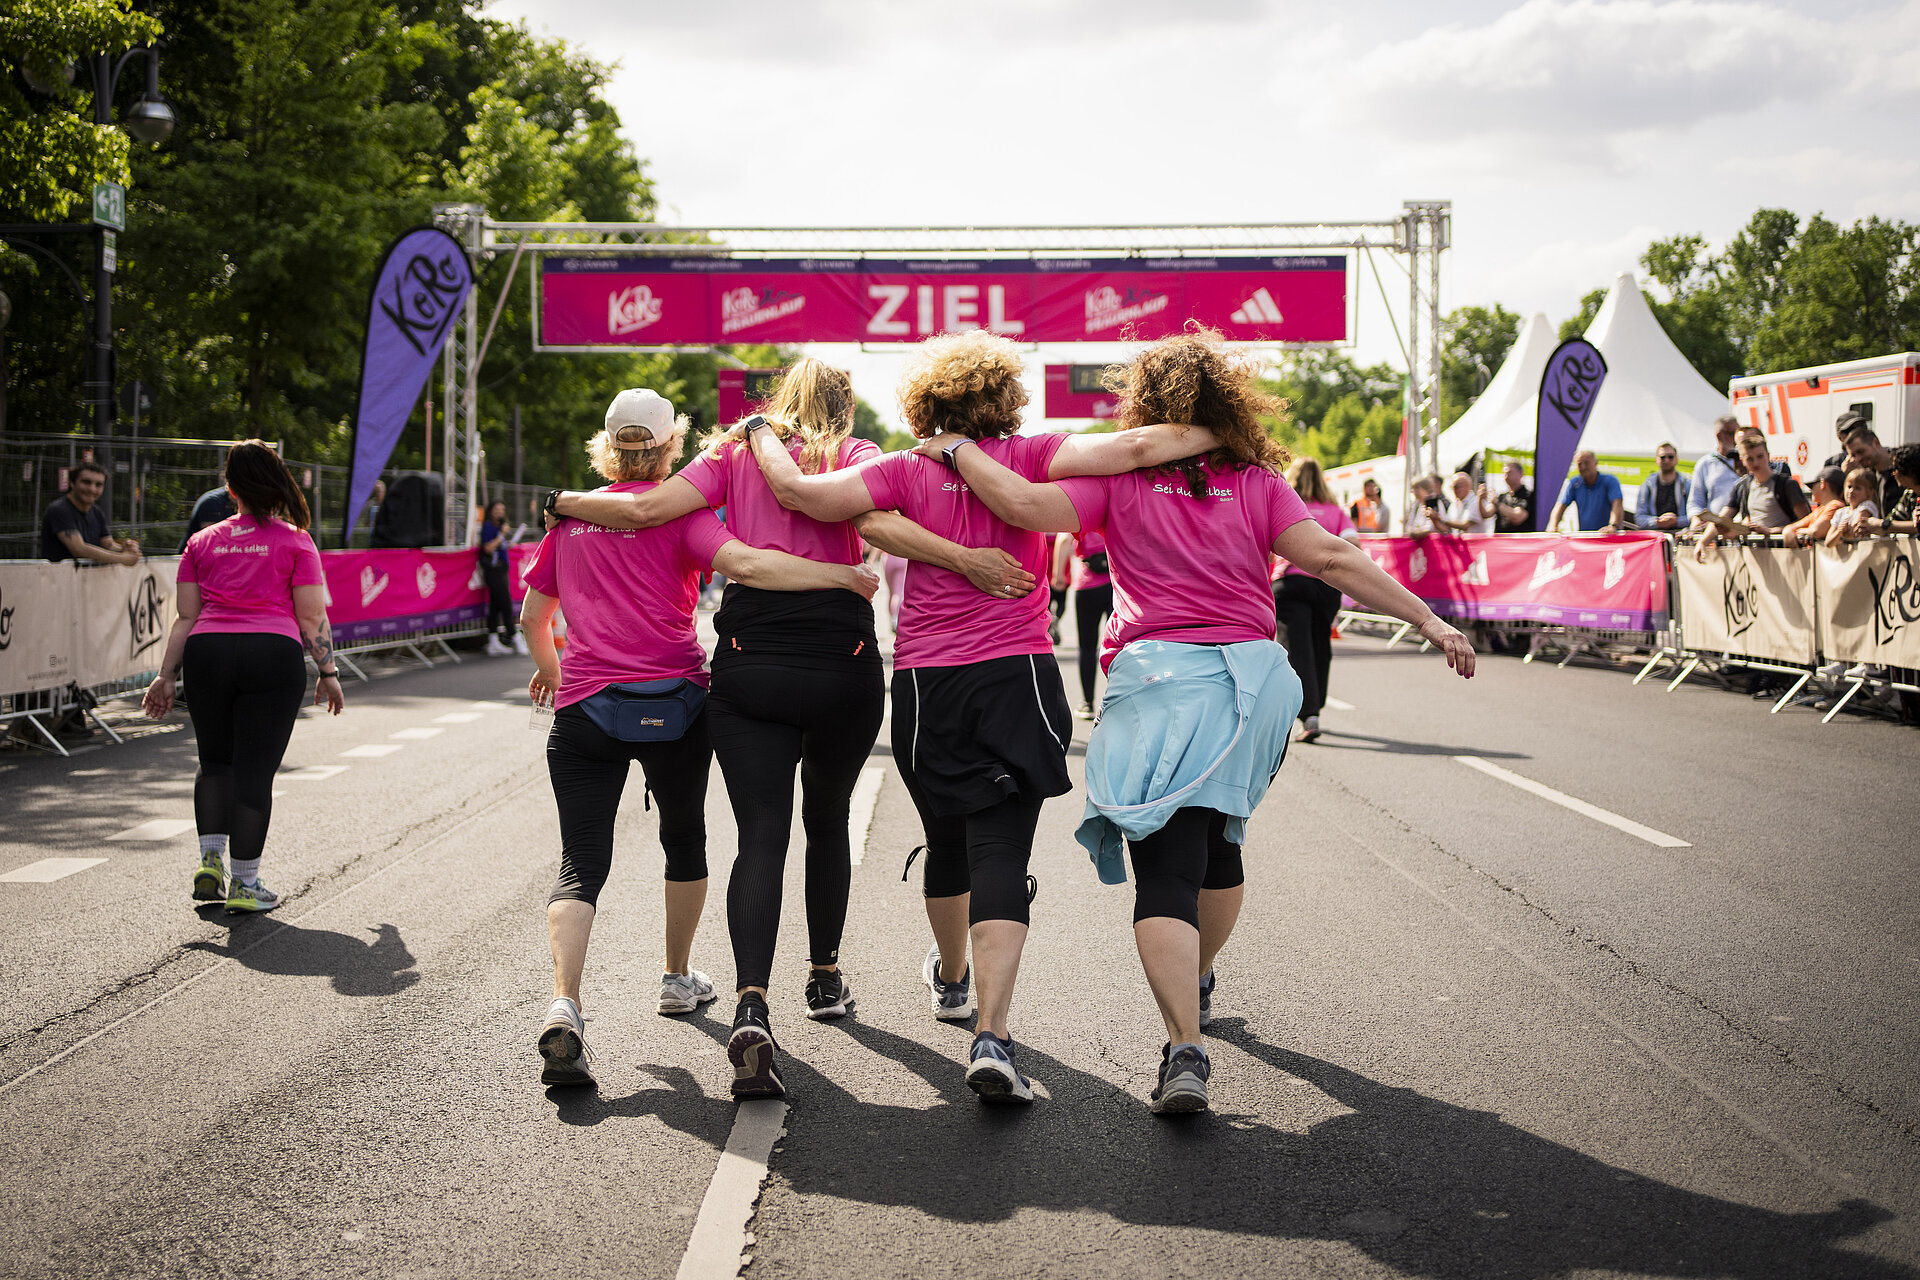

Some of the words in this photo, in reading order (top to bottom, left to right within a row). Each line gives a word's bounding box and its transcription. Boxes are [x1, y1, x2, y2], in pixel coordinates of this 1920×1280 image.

[380, 253, 465, 356] KoRo
[866, 284, 1025, 335] ZIEL
[1547, 352, 1601, 430] KoRo
[1152, 483, 1174, 494] Sei
[1176, 486, 1192, 497] du
[1205, 486, 1233, 496] lbst
[586, 523, 603, 533] du
[1723, 560, 1760, 638] KoRo
